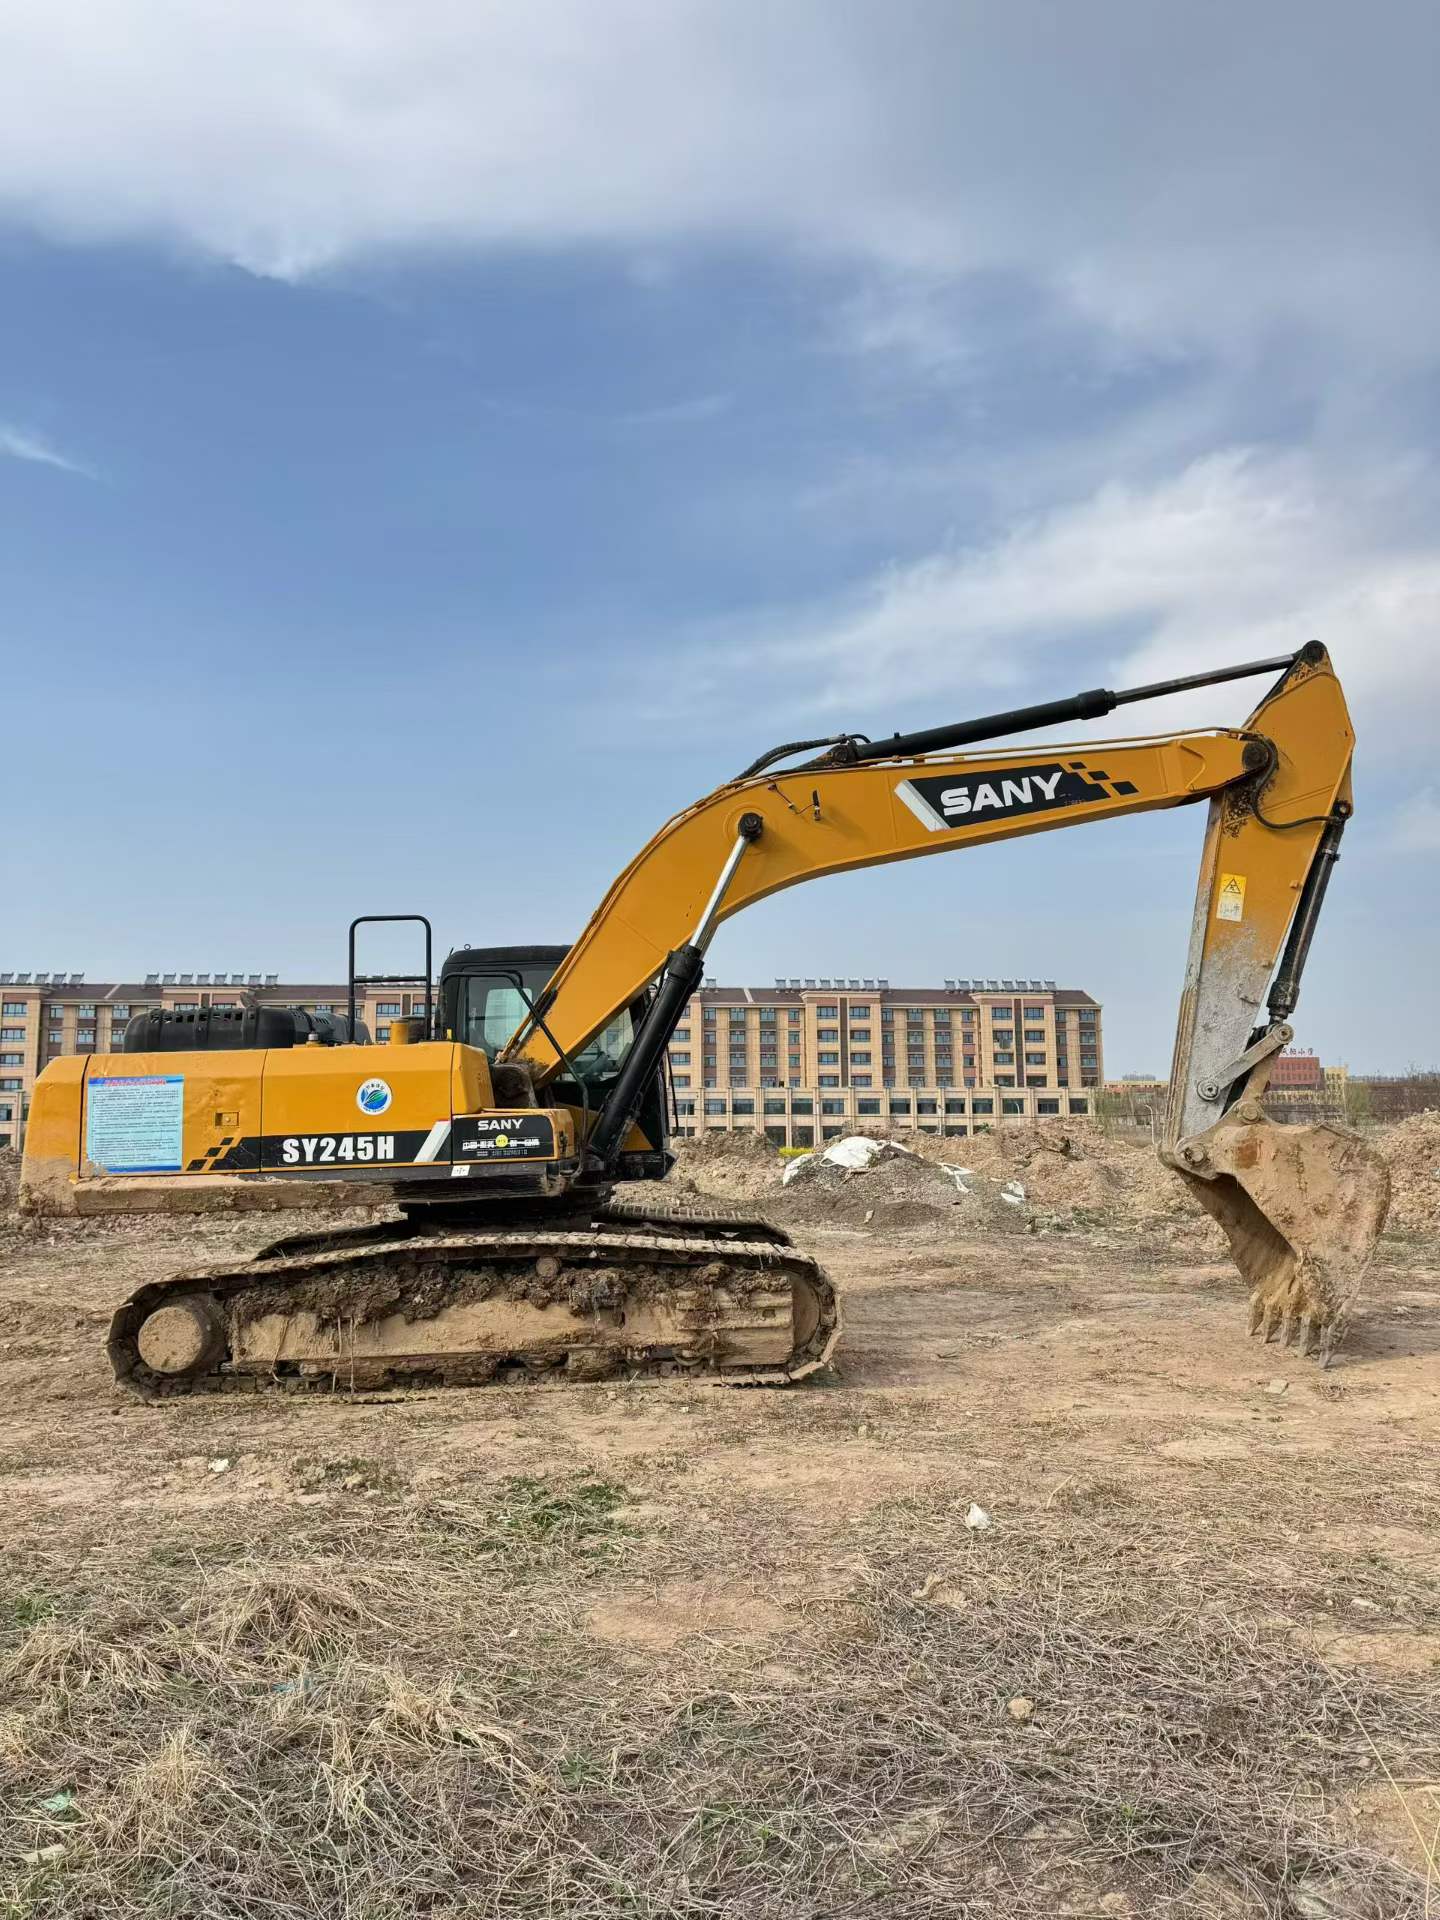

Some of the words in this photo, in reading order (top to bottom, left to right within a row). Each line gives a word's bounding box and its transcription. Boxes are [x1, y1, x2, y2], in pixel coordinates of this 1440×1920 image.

[940, 771, 1063, 817] SANY
[478, 1118, 524, 1131] SANY
[282, 1135, 395, 1164] SY245H
